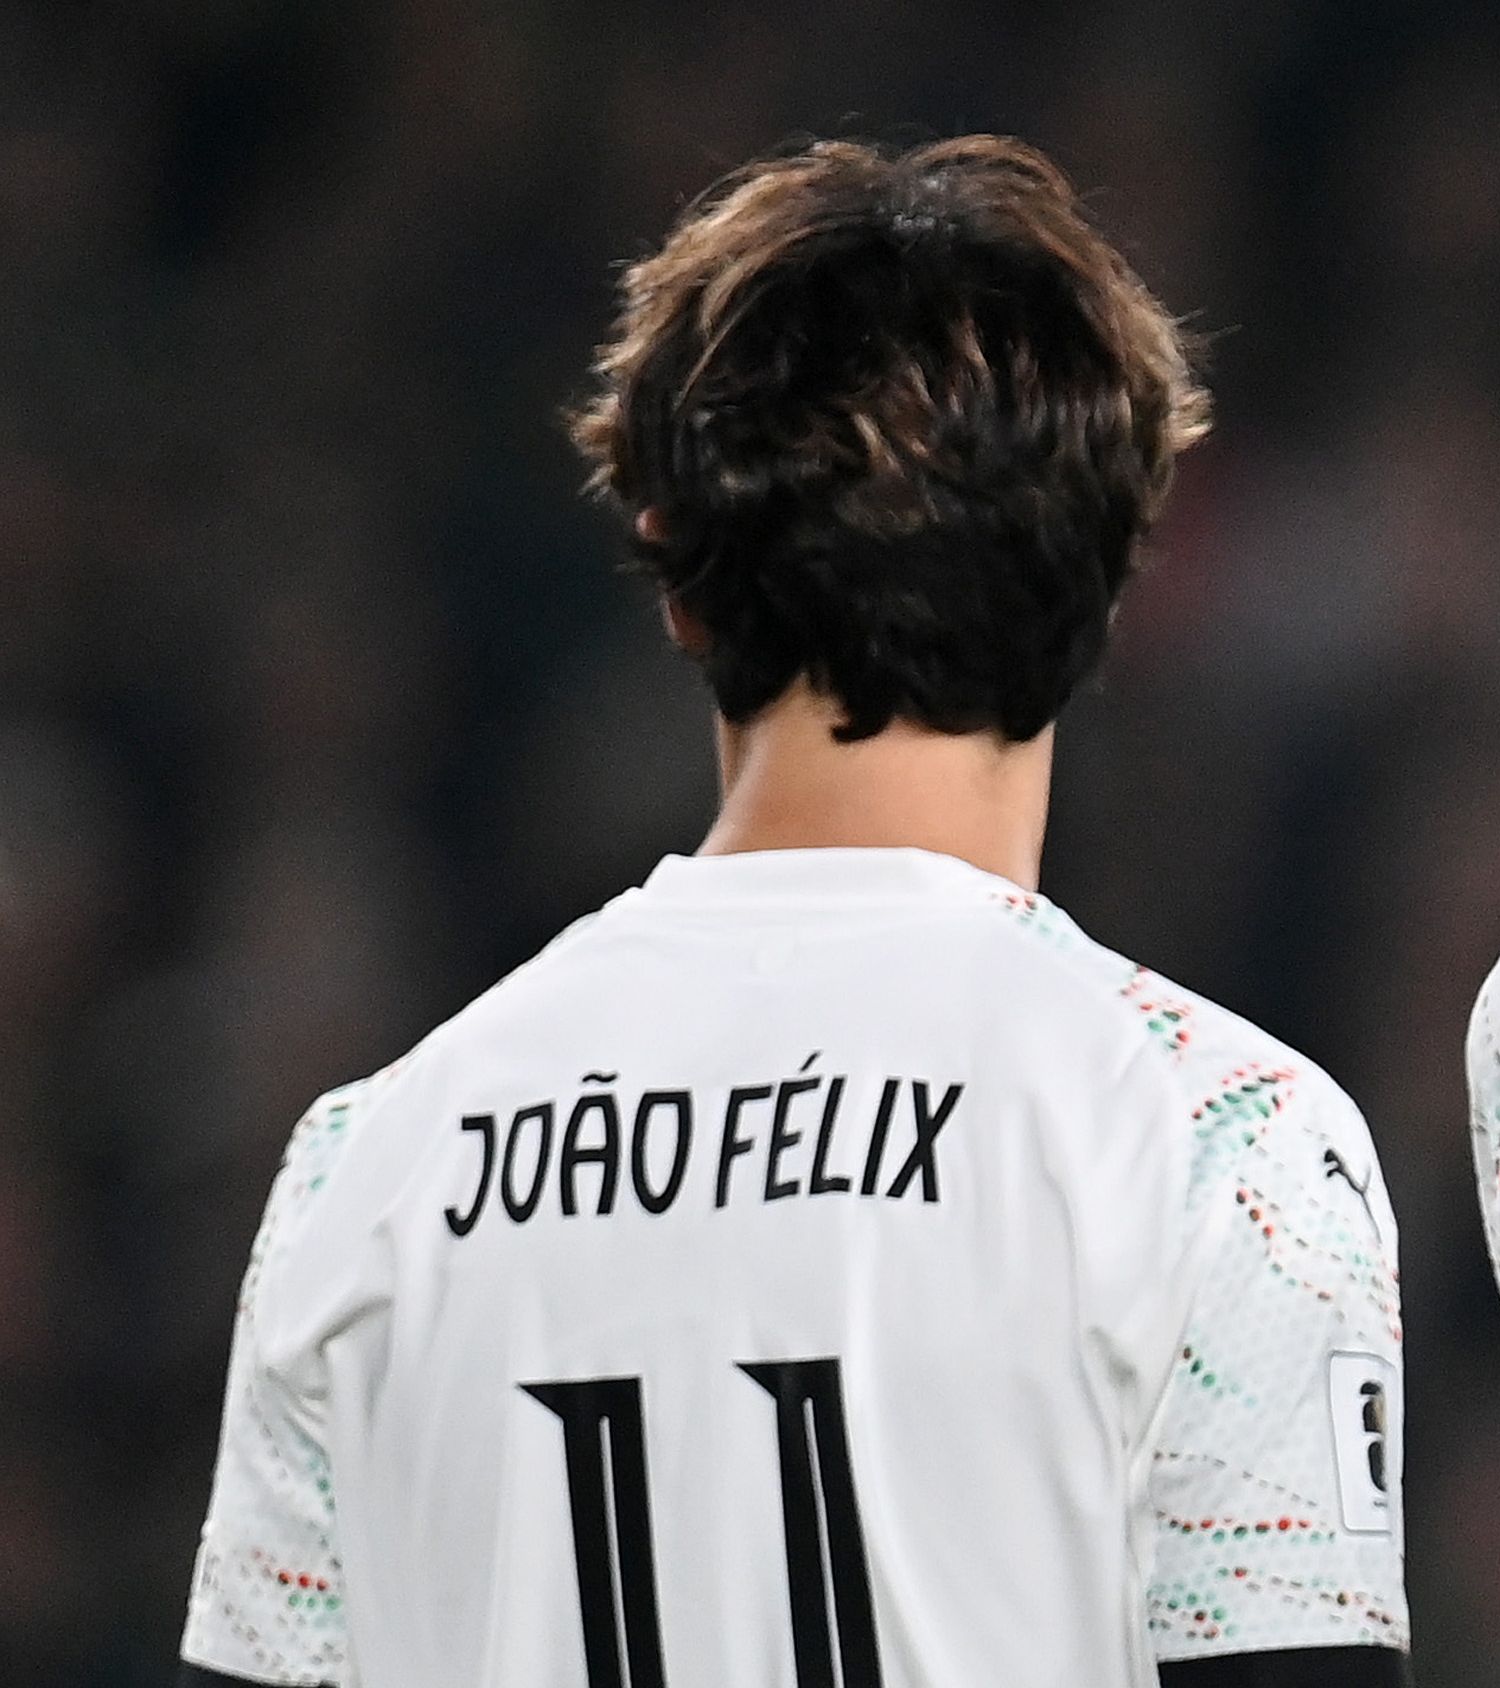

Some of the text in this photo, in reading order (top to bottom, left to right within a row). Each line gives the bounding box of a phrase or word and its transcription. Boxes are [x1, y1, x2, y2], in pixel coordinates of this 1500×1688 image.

[445, 1050, 964, 1237] JOÃO FÉLIX
[517, 1356, 886, 1688] 11
